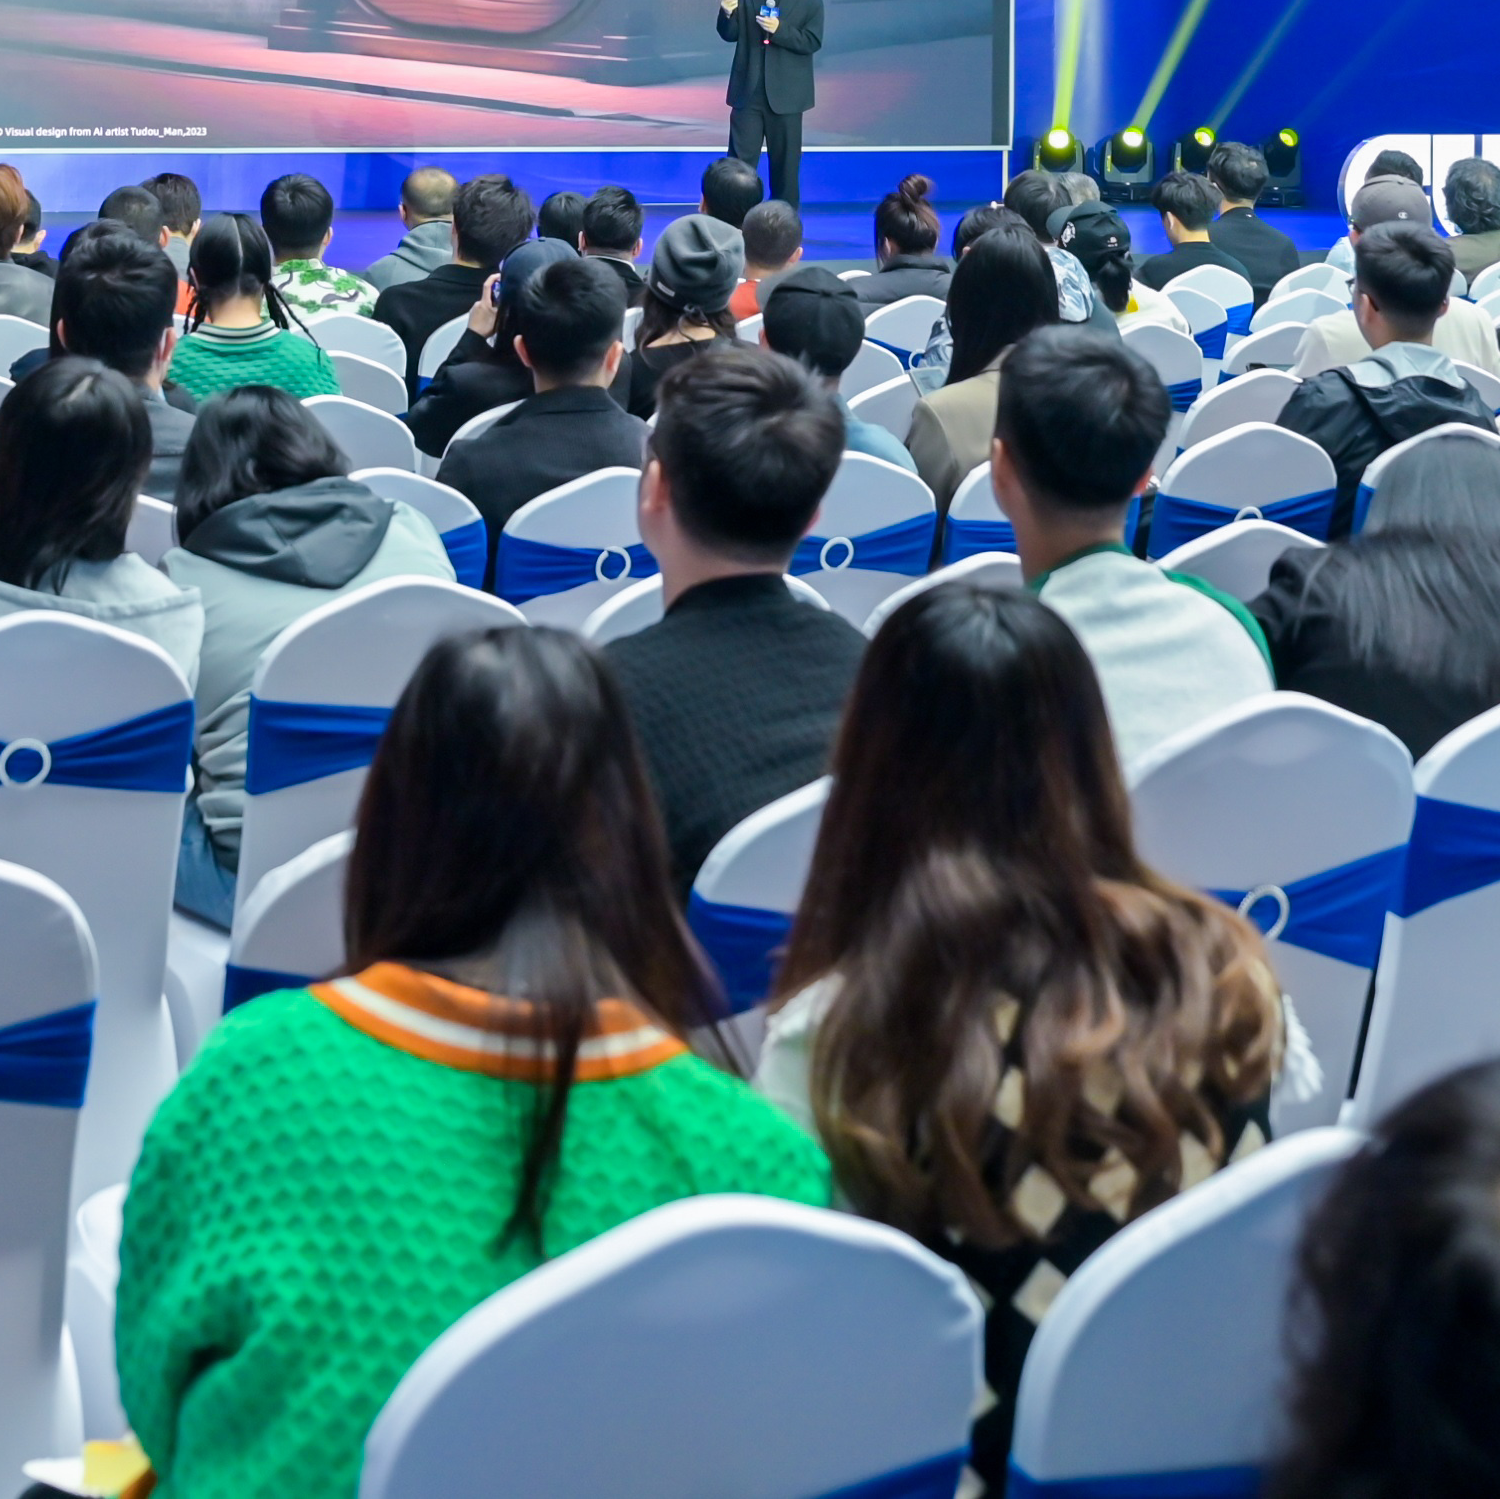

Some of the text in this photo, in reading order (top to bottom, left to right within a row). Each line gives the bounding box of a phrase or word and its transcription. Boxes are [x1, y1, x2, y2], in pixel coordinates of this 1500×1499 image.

[5, 127, 34, 136] Visual
[36, 127, 67, 138] design
[69, 127, 91, 136] from
[105, 127, 129, 136] artist
